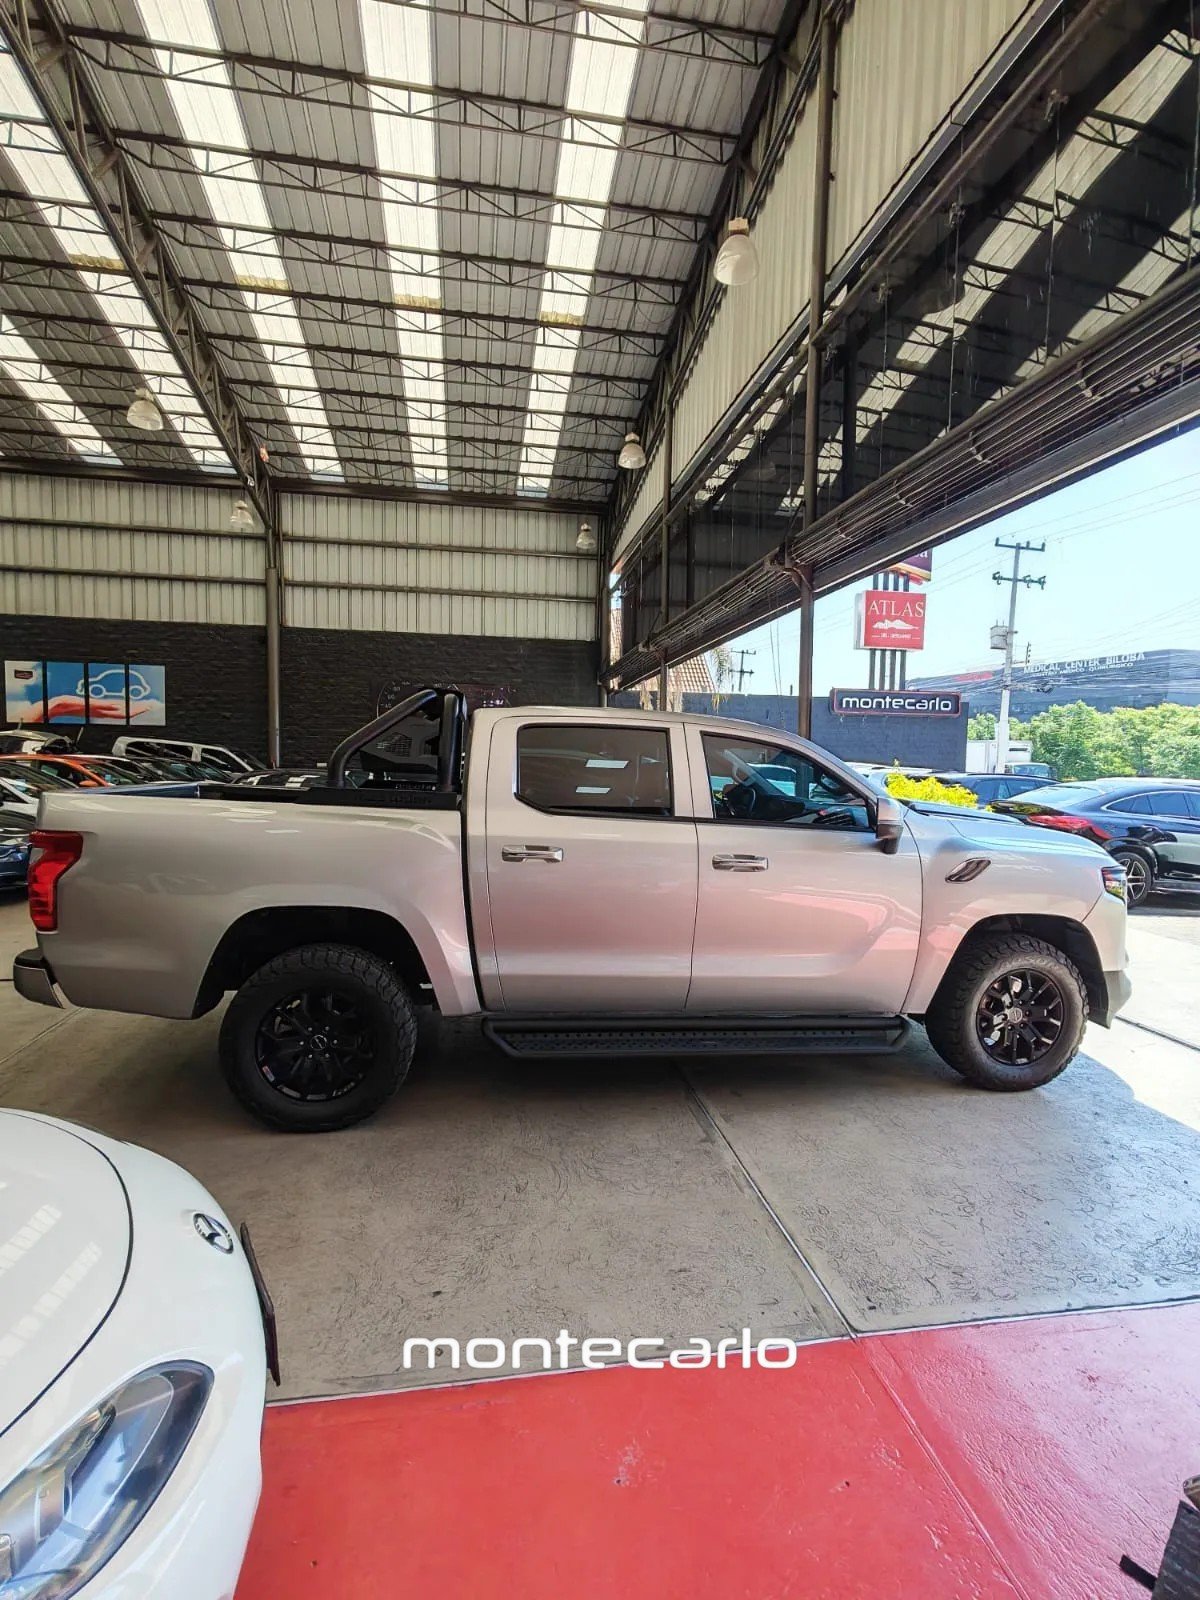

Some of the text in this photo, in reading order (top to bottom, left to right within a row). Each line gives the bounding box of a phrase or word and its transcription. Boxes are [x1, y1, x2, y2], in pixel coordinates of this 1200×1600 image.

[867, 600, 924, 617] ATLAS
[1024, 653, 1145, 674] MEDICAL CENTER BILOBA
[842, 695, 952, 711] montecarlo
